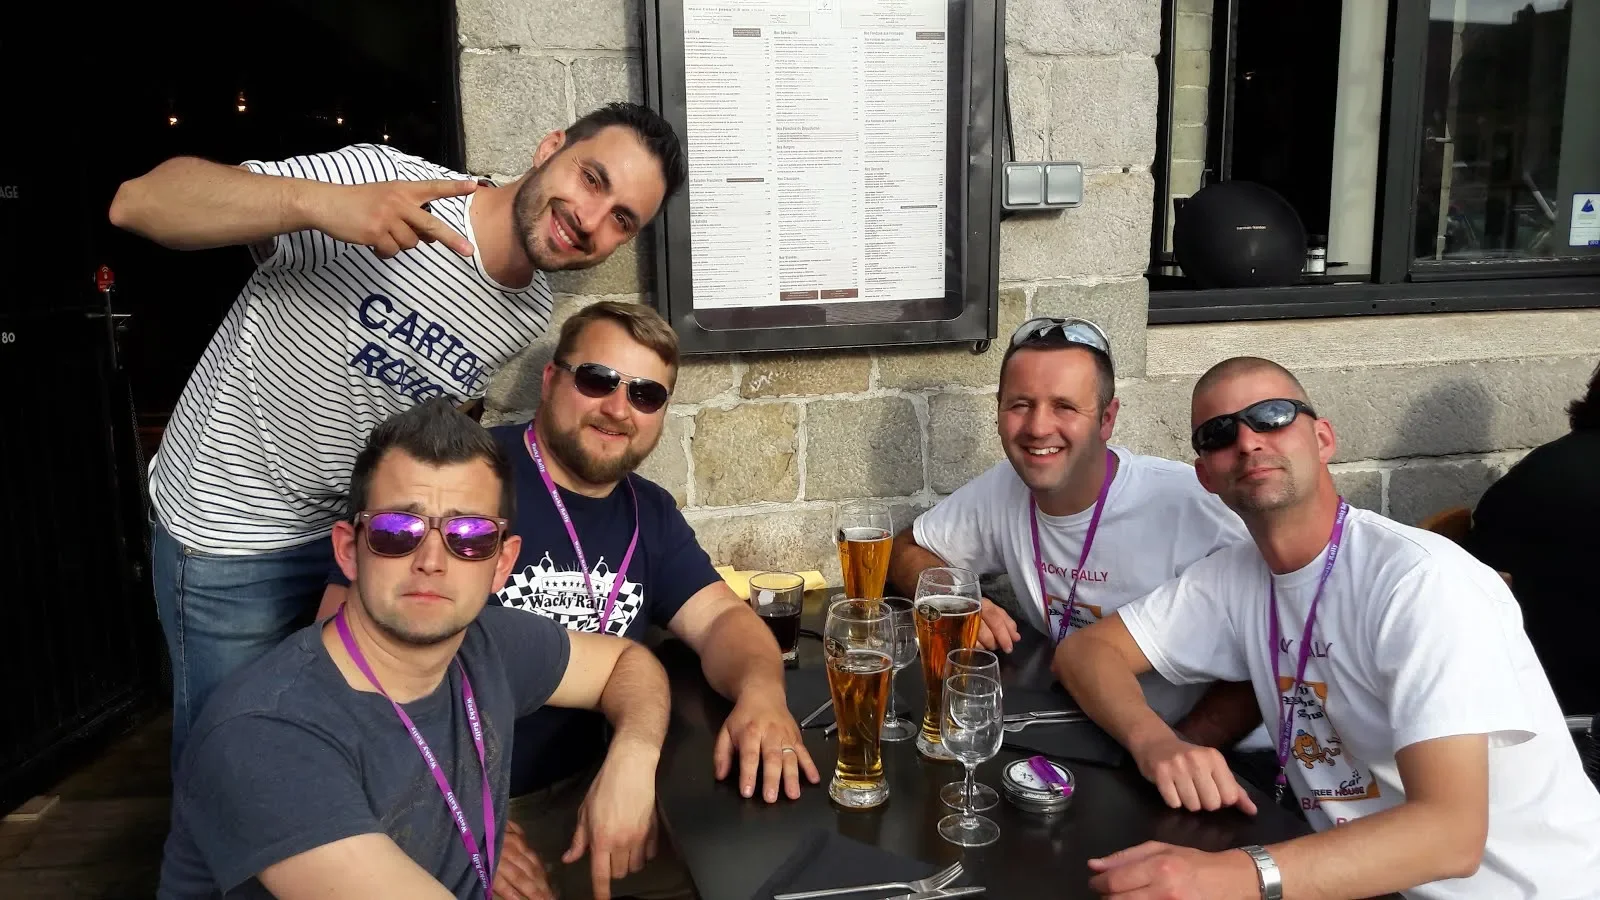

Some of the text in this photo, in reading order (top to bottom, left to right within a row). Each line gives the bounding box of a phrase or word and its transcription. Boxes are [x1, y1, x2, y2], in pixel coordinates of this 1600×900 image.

[2, 332, 15, 344] 80
[1036, 561, 1109, 582] ACKY RALLY
[527, 593, 572, 612] Wacky
[466, 697, 481, 741] Wacky Rally
[411, 726, 437, 770] Wacky Rally
[1335, 786, 1365, 797] HOUSE
[447, 791, 467, 833] Wacky Rally
